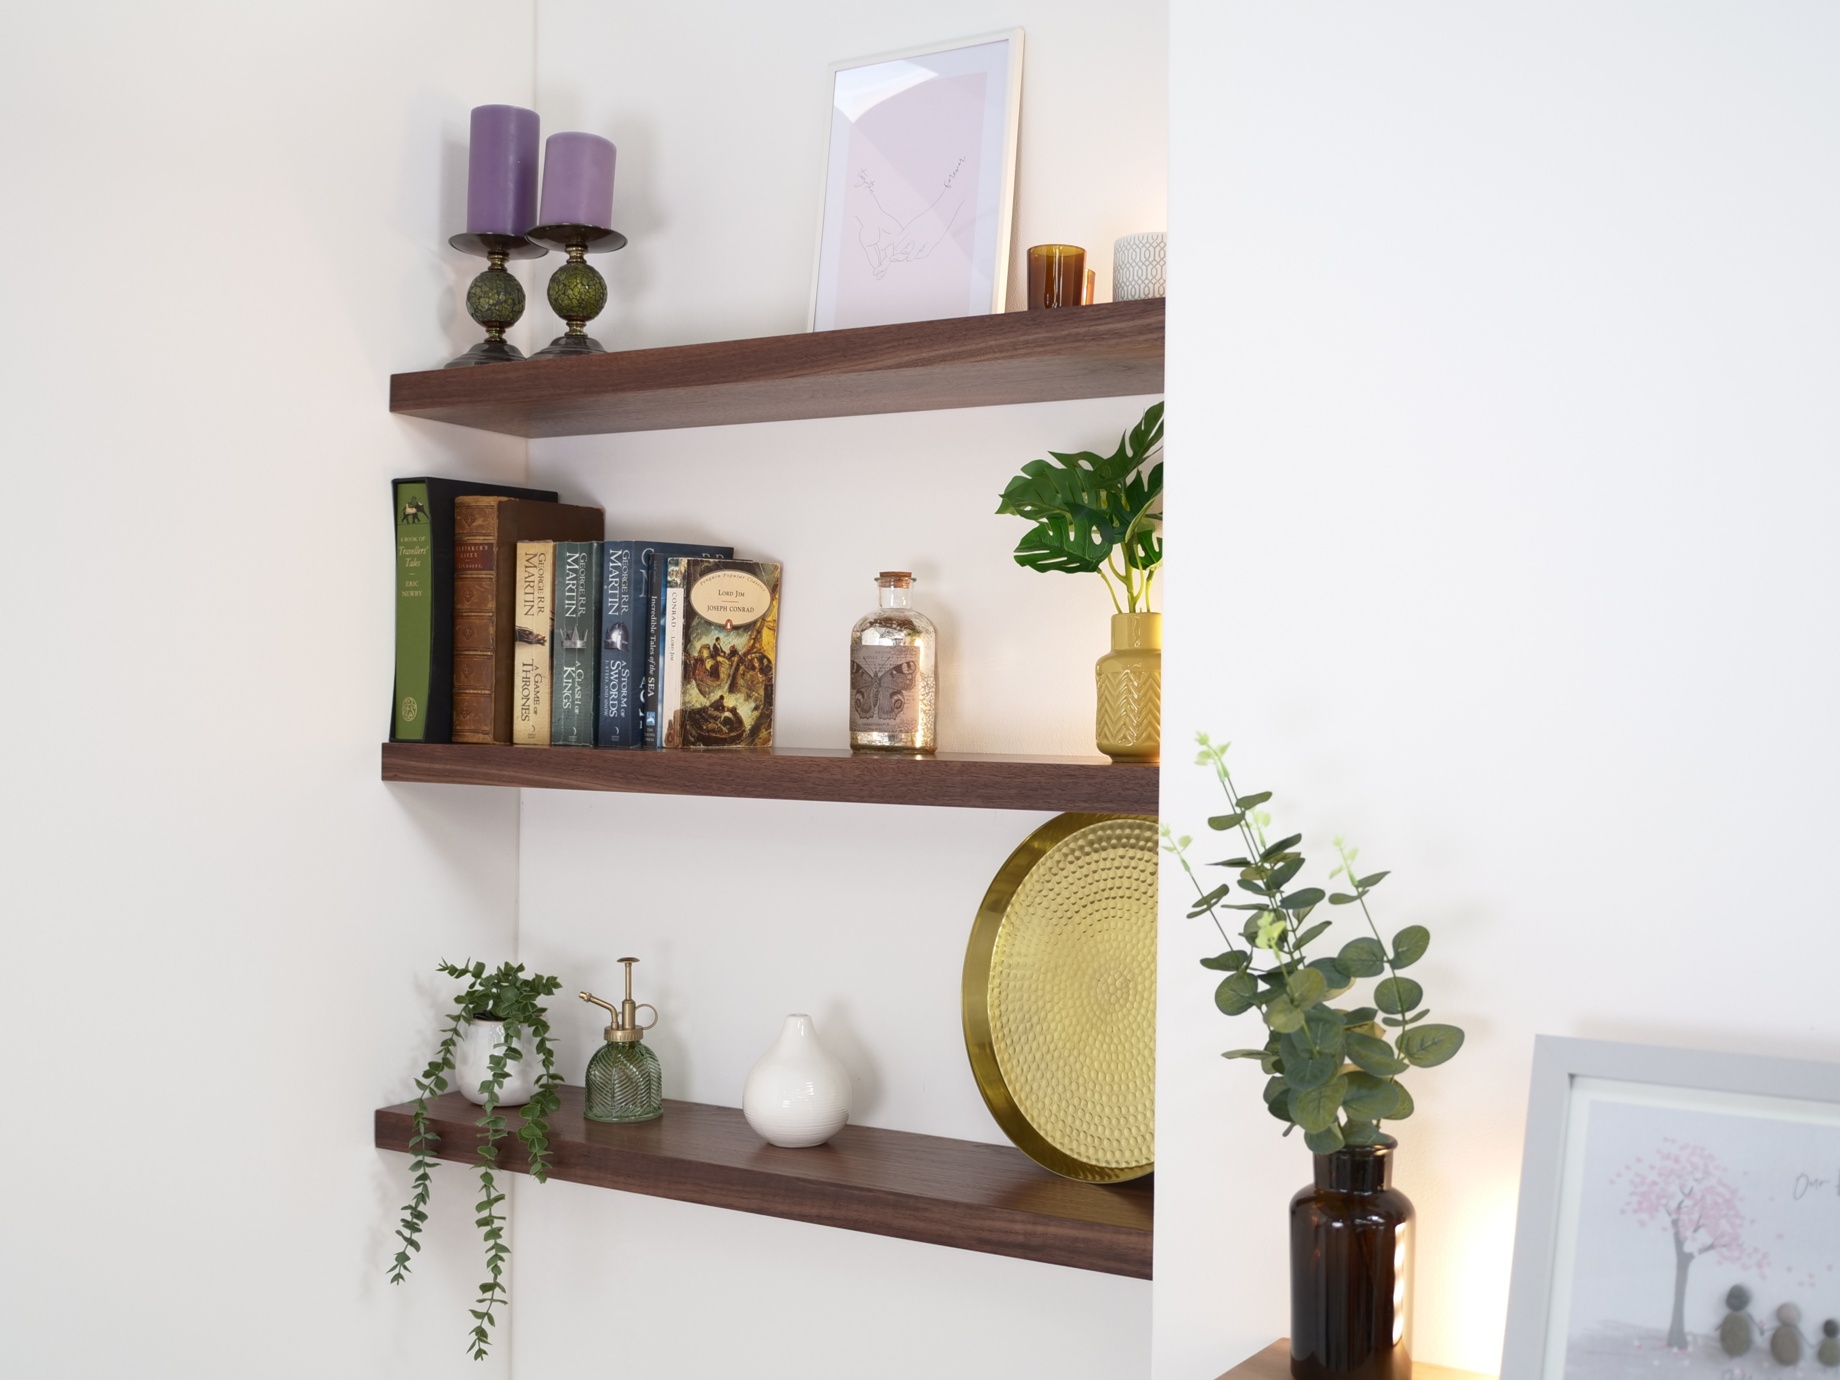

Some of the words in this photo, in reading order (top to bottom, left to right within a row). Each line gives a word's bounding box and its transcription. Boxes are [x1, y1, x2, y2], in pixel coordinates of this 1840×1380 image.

[405, 557, 421, 567] Tales
[537, 552, 547, 595] GEORGE
[579, 552, 588, 595] GEORGE
[621, 549, 630, 593] GEORGE
[524, 552, 538, 617] MARTIN
[565, 552, 580, 618] MARTIN
[608, 549, 622, 616] MARTIN
[699, 574, 721, 586] Penguin
[746, 577, 766, 592] Classics
[735, 590, 745, 598] JIM
[650, 595, 658, 634] Incredible
[648, 656, 656, 665] of
[649, 635, 657, 655] Tales
[562, 666, 576, 709] KINGS
[575, 669, 584, 704] CLASH
[647, 676, 655, 697] SEA
[648, 665, 656, 675] the
[521, 658, 534, 722] THRONES
[533, 673, 543, 705] GAME
[609, 660, 622, 718] SWORDS
[620, 668, 630, 708] STORM
[533, 707, 538, 715] OF
[574, 705, 580, 715] OF
[620, 708, 625, 718] OF
